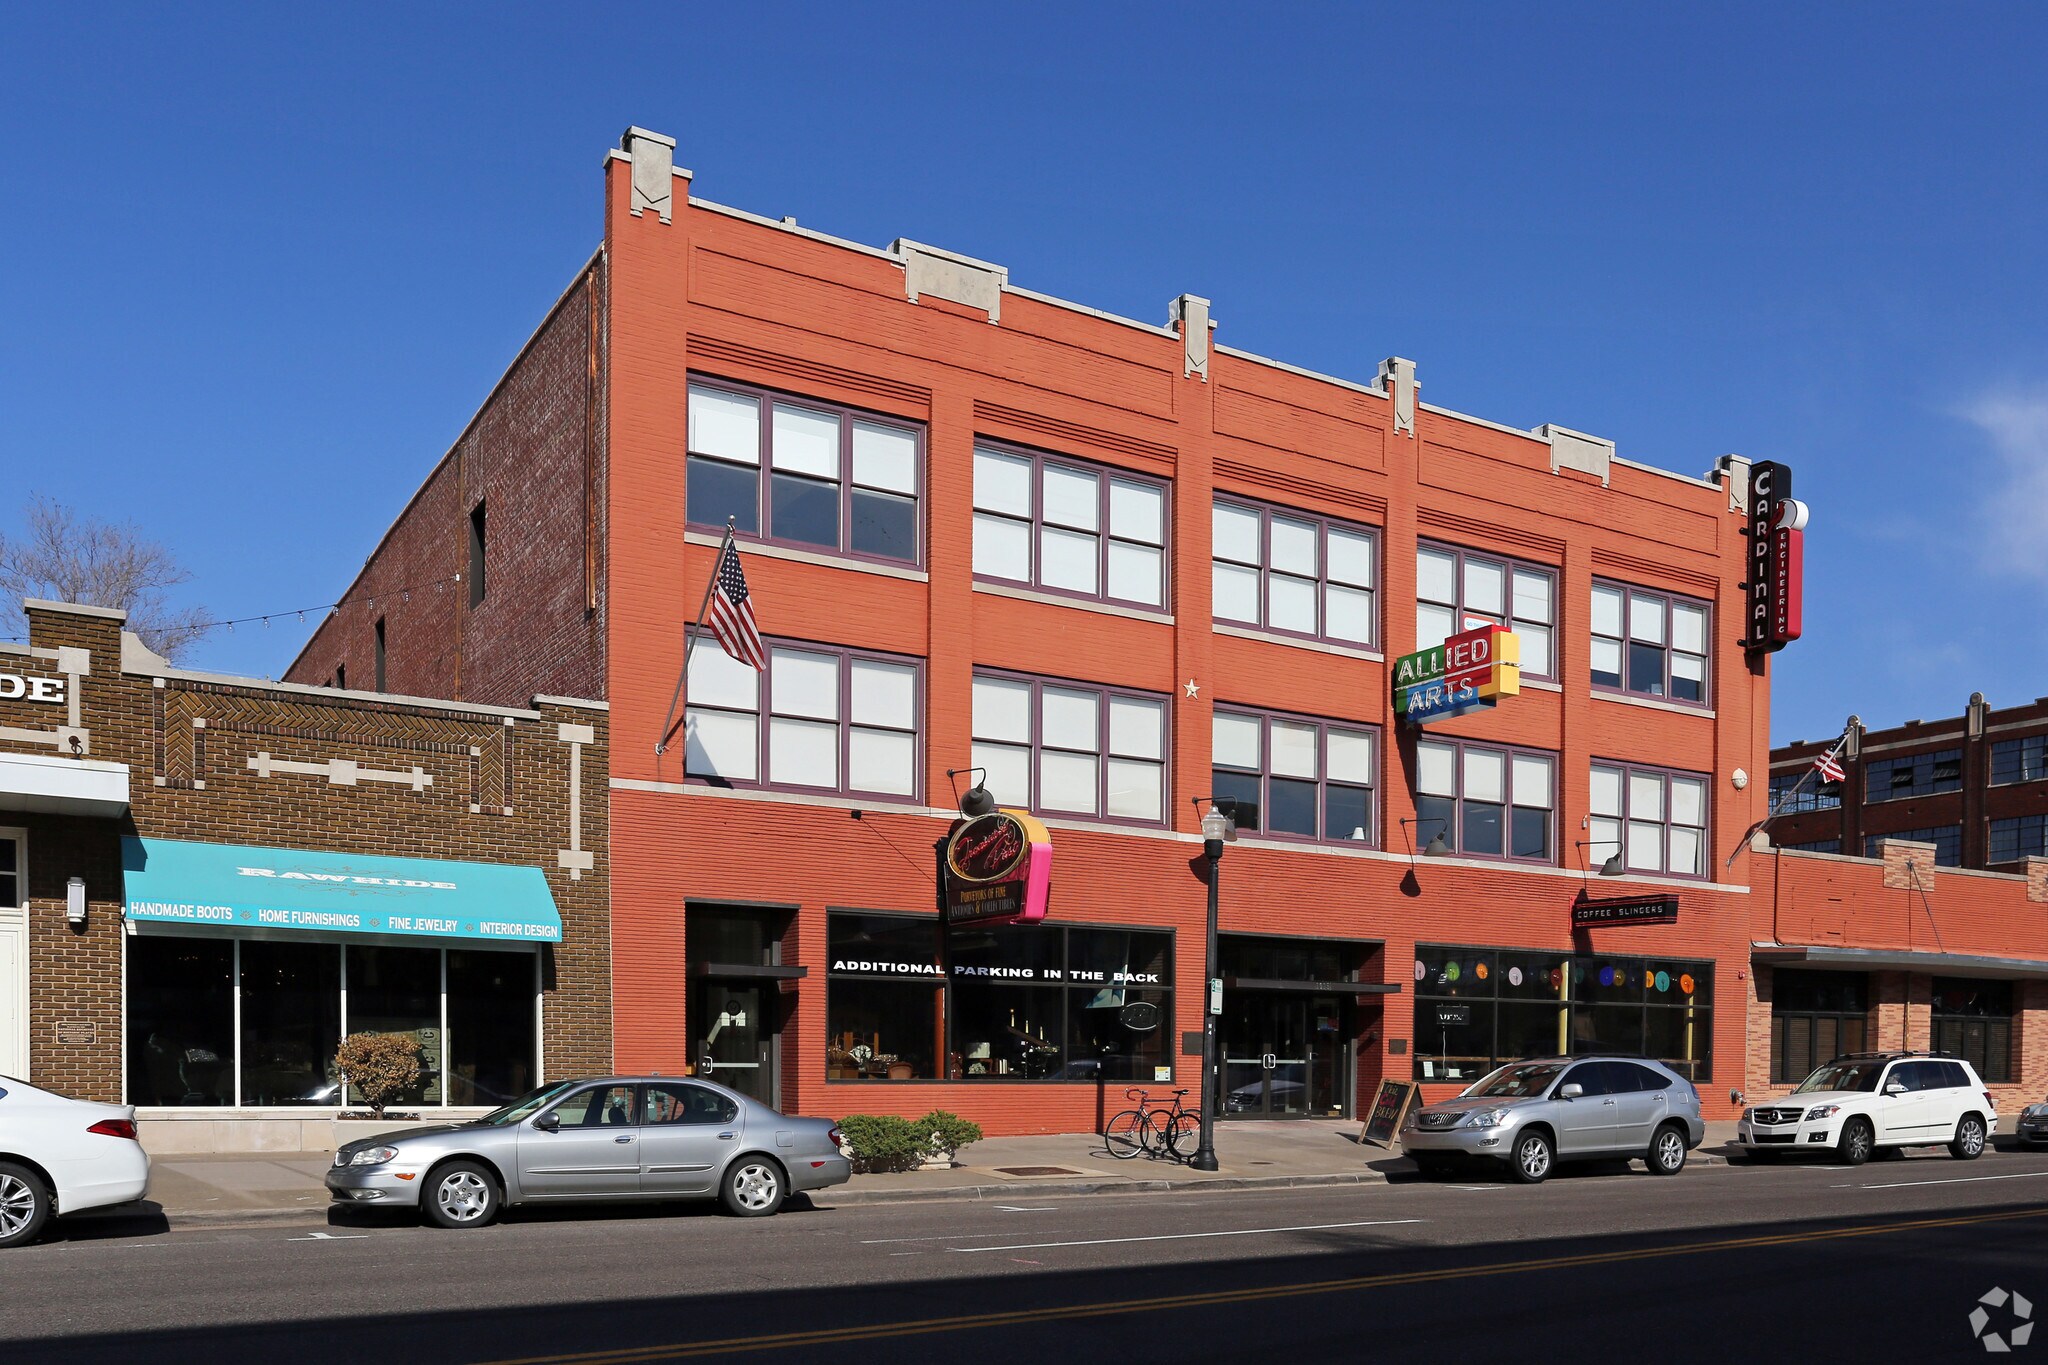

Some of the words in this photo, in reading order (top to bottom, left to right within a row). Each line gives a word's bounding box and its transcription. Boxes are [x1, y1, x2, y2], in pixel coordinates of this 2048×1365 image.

[1755, 471, 1771, 640] CARDINAL
[1778, 532, 1786, 634] ENGINEERING
[1398, 638, 1488, 682] ALLIED
[1408, 677, 1473, 713] ARTS
[236, 867, 457, 890] RAWHIDE
[987, 888, 994, 899] OF
[995, 886, 1006, 898] FINE
[130, 902, 194, 918] HANDMADE
[196, 905, 233, 920] BOOTS
[258, 909, 289, 924] HOME
[291, 910, 360, 927] FURNISHINGS
[389, 916, 411, 930] FINE
[413, 918, 458, 932] JEWELRY
[480, 922, 522, 936] INTERIOR
[524, 924, 558, 938] DESIGN
[975, 901, 981, 914] &
[1577, 909, 1611, 919] COFFEE
[1618, 905, 1663, 916] SLINGERS
[833, 960, 946, 974] ADDITIONAL
[954, 966, 1033, 978] PARKING
[1044, 969, 1061, 979] IN
[1070, 970, 1103, 980] THE
[1113, 972, 1159, 983] BACK
